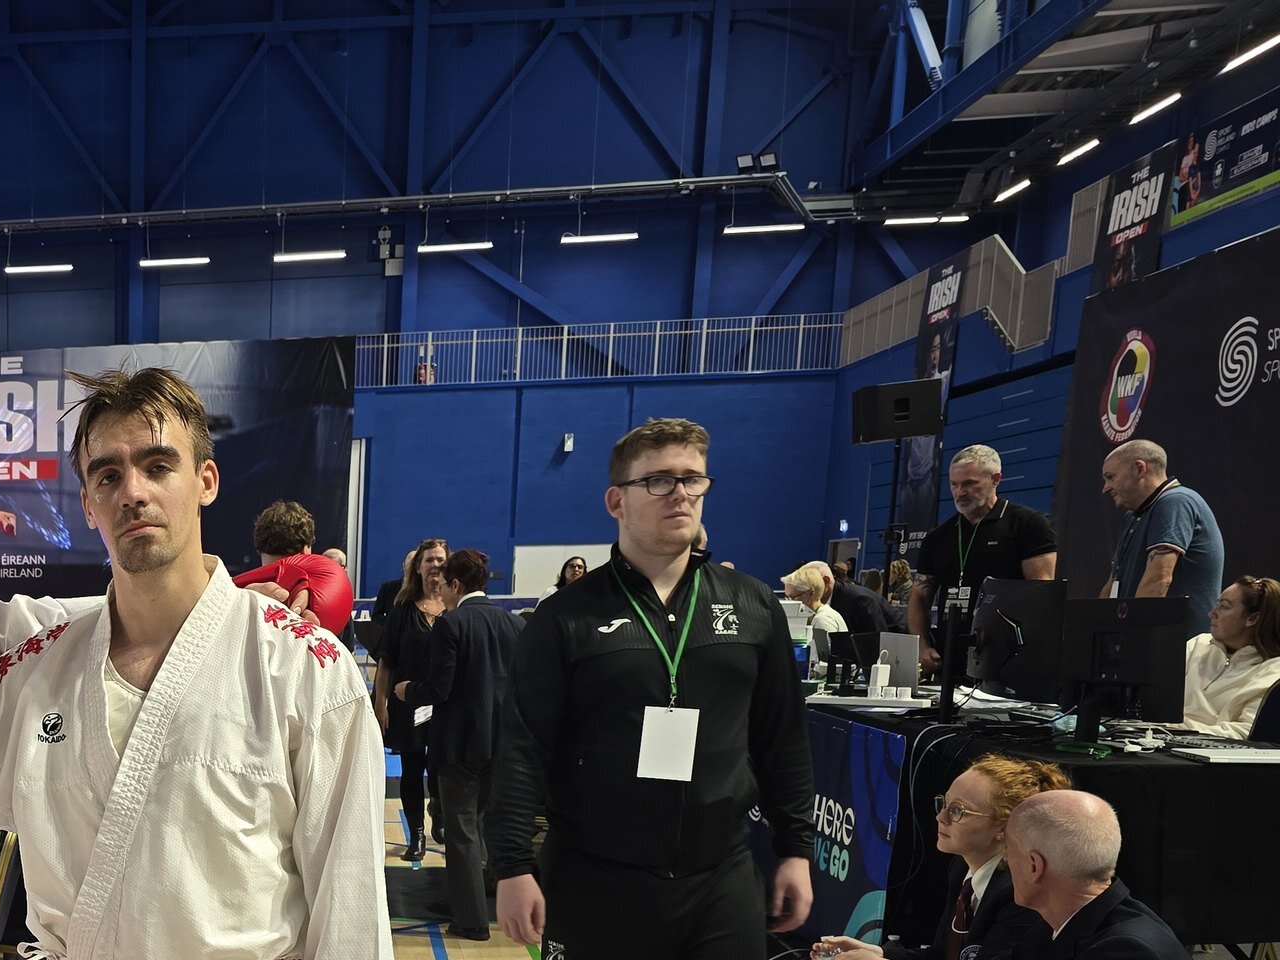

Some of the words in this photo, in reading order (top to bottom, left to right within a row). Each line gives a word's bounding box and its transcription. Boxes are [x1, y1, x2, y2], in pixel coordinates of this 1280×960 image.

[1131, 165, 1150, 184] THE
[1107, 172, 1165, 235] IRISH
[1115, 223, 1145, 244] OPEN
[941, 265, 954, 278] THE
[927, 271, 962, 315] IRISH
[1117, 372, 1145, 399] WKF
[1, 553, 46, 566] ÉIREANN
[0, 568, 43, 578] IRELAND
[37, 733, 66, 744] TOKAIDO
[830, 844, 849, 882] GO
